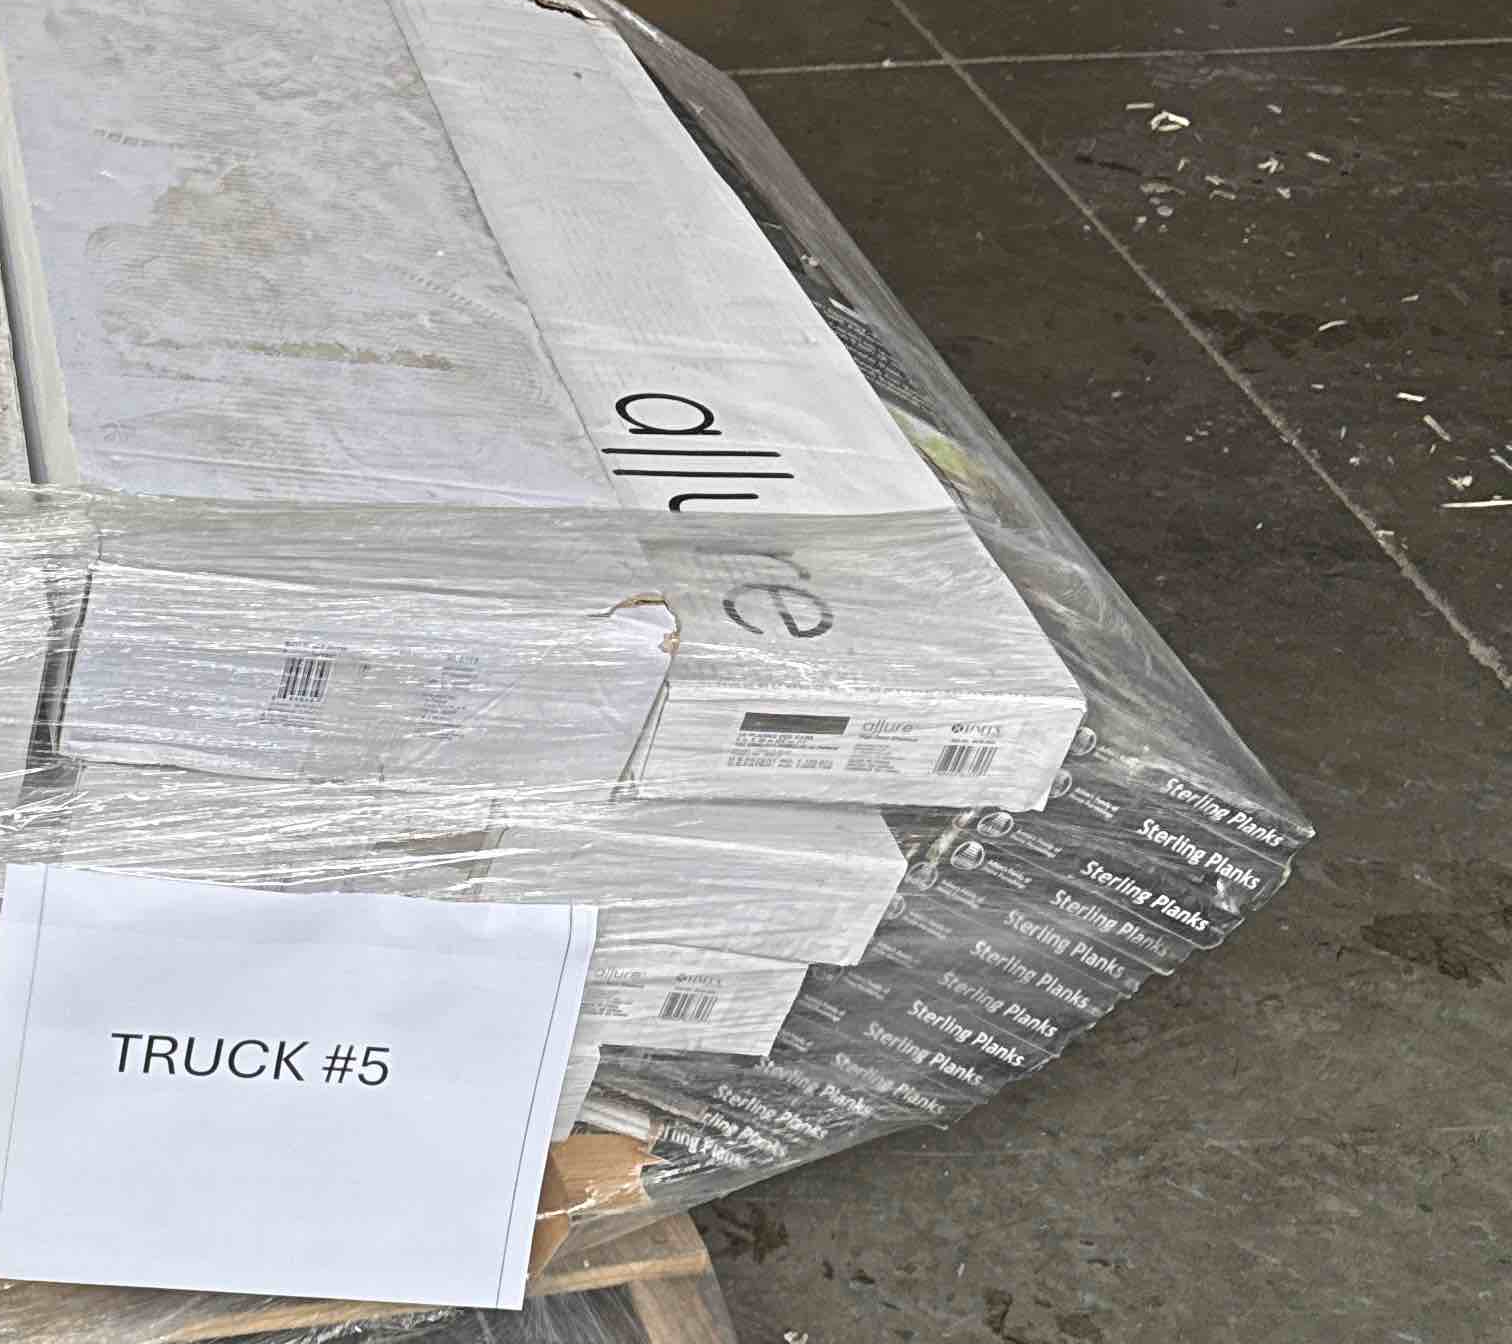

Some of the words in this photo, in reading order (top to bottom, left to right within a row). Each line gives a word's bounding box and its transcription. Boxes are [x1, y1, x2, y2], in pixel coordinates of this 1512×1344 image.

[1159, 777, 1229, 822] Sterling
[1227, 811, 1285, 848] Planks
[1136, 818, 1206, 865] Sterling
[1203, 852, 1261, 890] Planks
[1049, 889, 1119, 933] Sterling
[1116, 921, 1169, 958] Planks
[1080, 860, 1152, 906] Sterling
[1150, 894, 1209, 932] Planks
[970, 940, 1037, 985] Sterling
[1035, 972, 1092, 1010] Planks
[1003, 909, 1073, 955] Sterling
[1070, 940, 1125, 979] Planks
[907, 999, 974, 1044] Sterling
[971, 1031, 1025, 1067] Planks
[939, 970, 1005, 1014] Sterling
[1002, 1003, 1059, 1038] Planks
[111, 1032, 310, 1082] TRUCK
[321, 1043, 390, 1086] #5
[864, 1021, 932, 1065] Sterling
[929, 1051, 984, 1087] Planks
